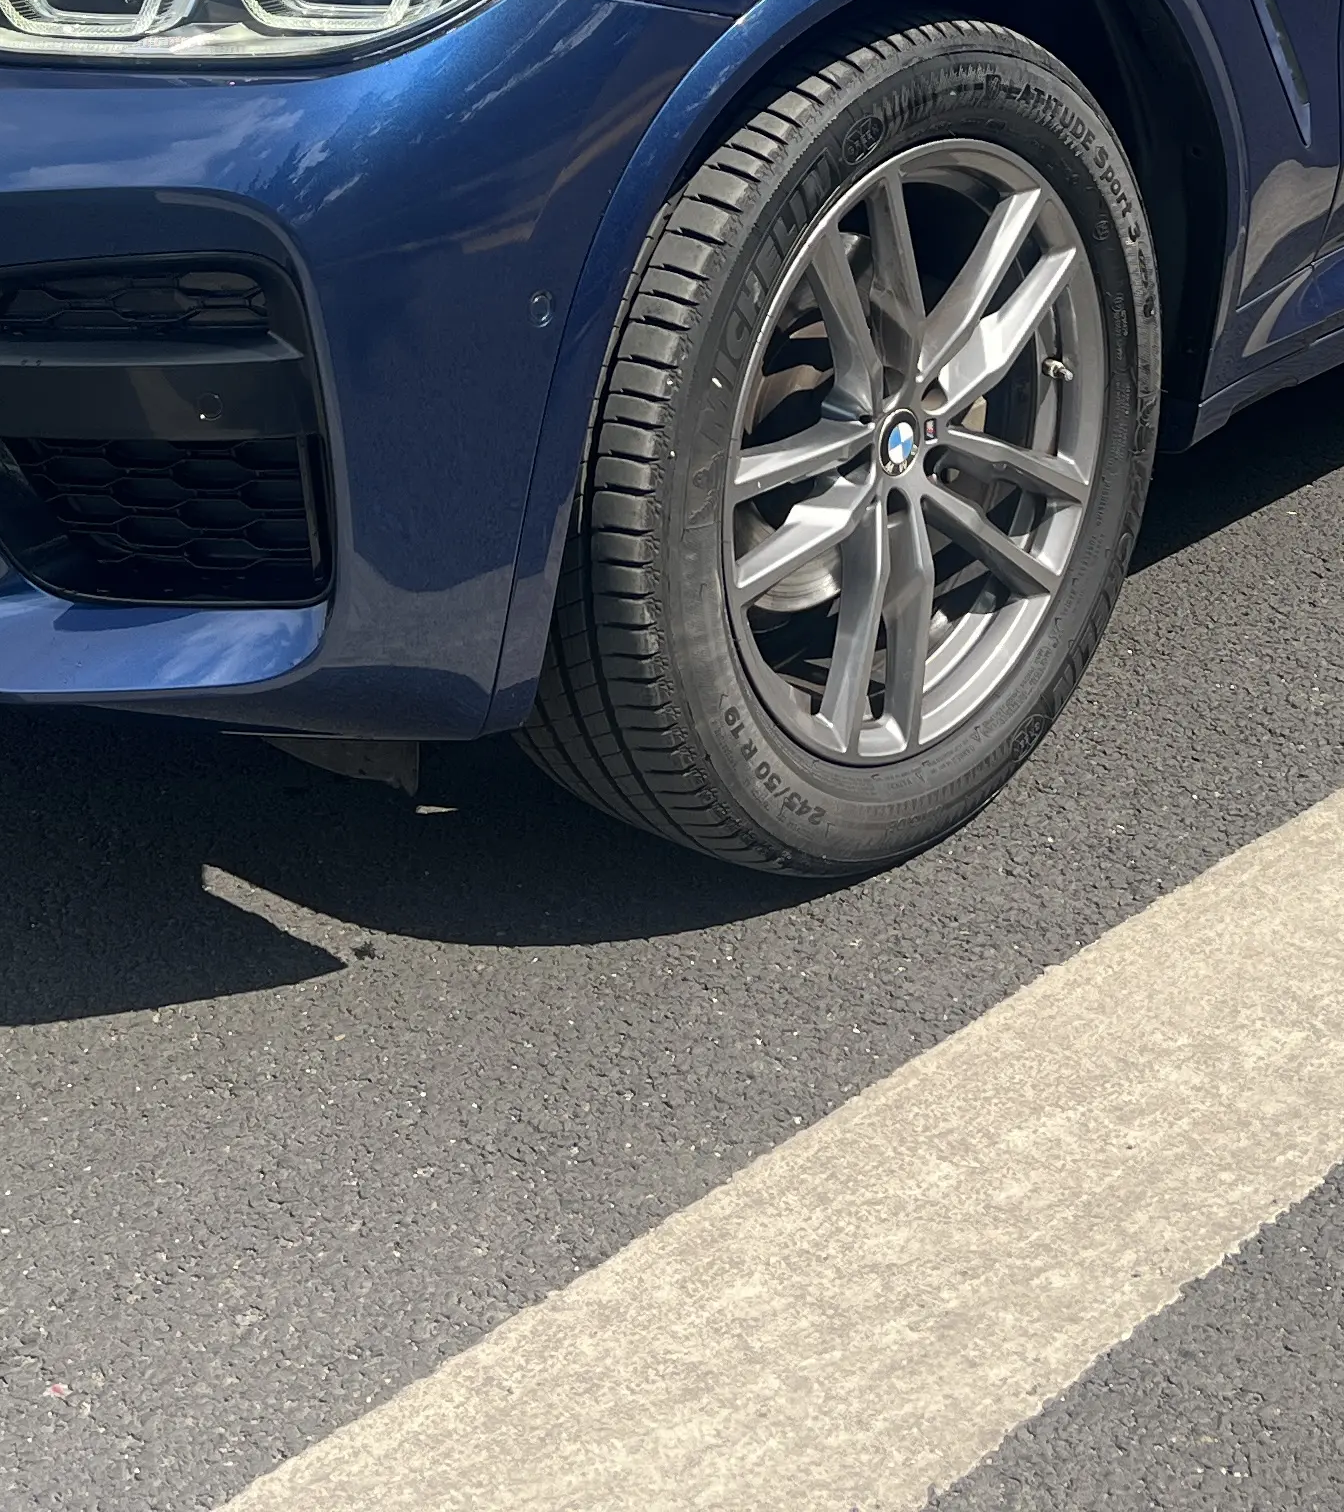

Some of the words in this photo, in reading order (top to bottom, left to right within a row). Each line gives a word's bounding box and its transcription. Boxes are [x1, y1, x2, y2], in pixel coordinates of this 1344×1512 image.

[1092, 142, 1136, 222] Sport
[1127, 223, 1140, 242] 3
[724, 705, 745, 741] 19
[740, 738, 759, 759] R
